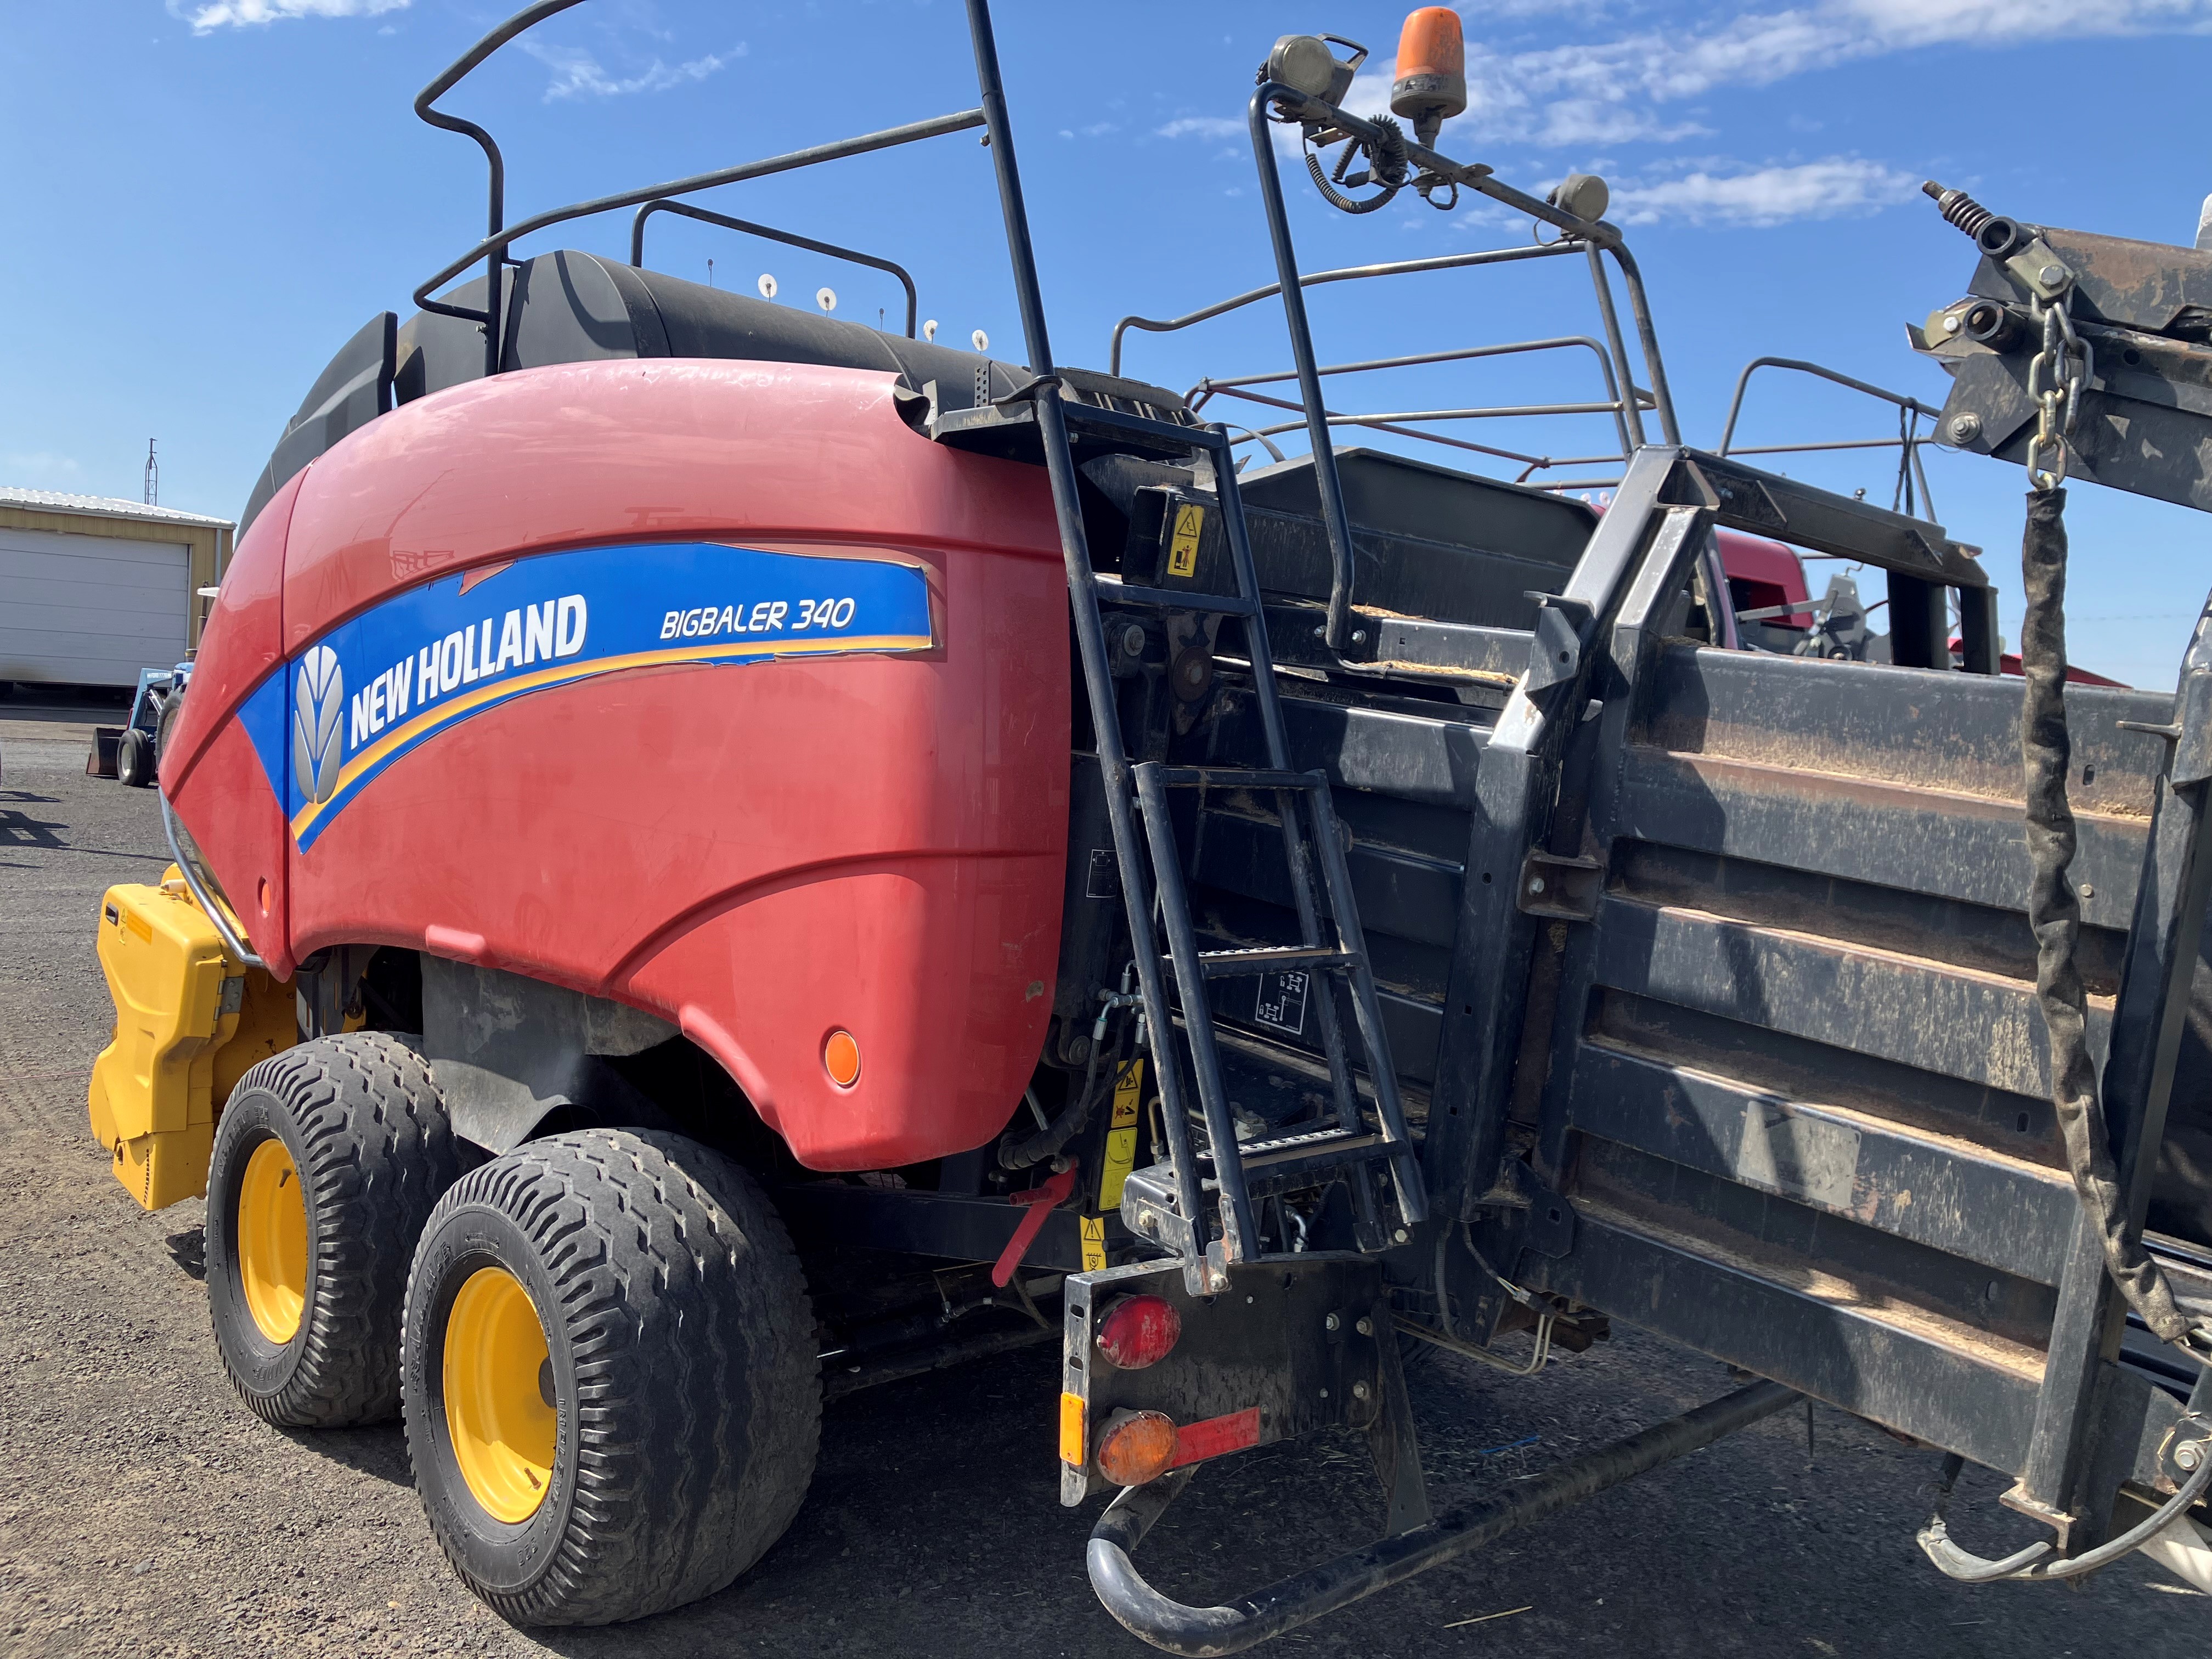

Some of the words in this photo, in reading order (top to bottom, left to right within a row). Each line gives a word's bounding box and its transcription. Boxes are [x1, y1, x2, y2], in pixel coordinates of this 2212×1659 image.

[351, 654, 414, 751] NEW
[416, 594, 588, 707] HOLLAND
[659, 600, 789, 641] BIGBALER
[791, 597, 856, 630] 340
[541, 1398, 567, 1534] IMPLEMENT
